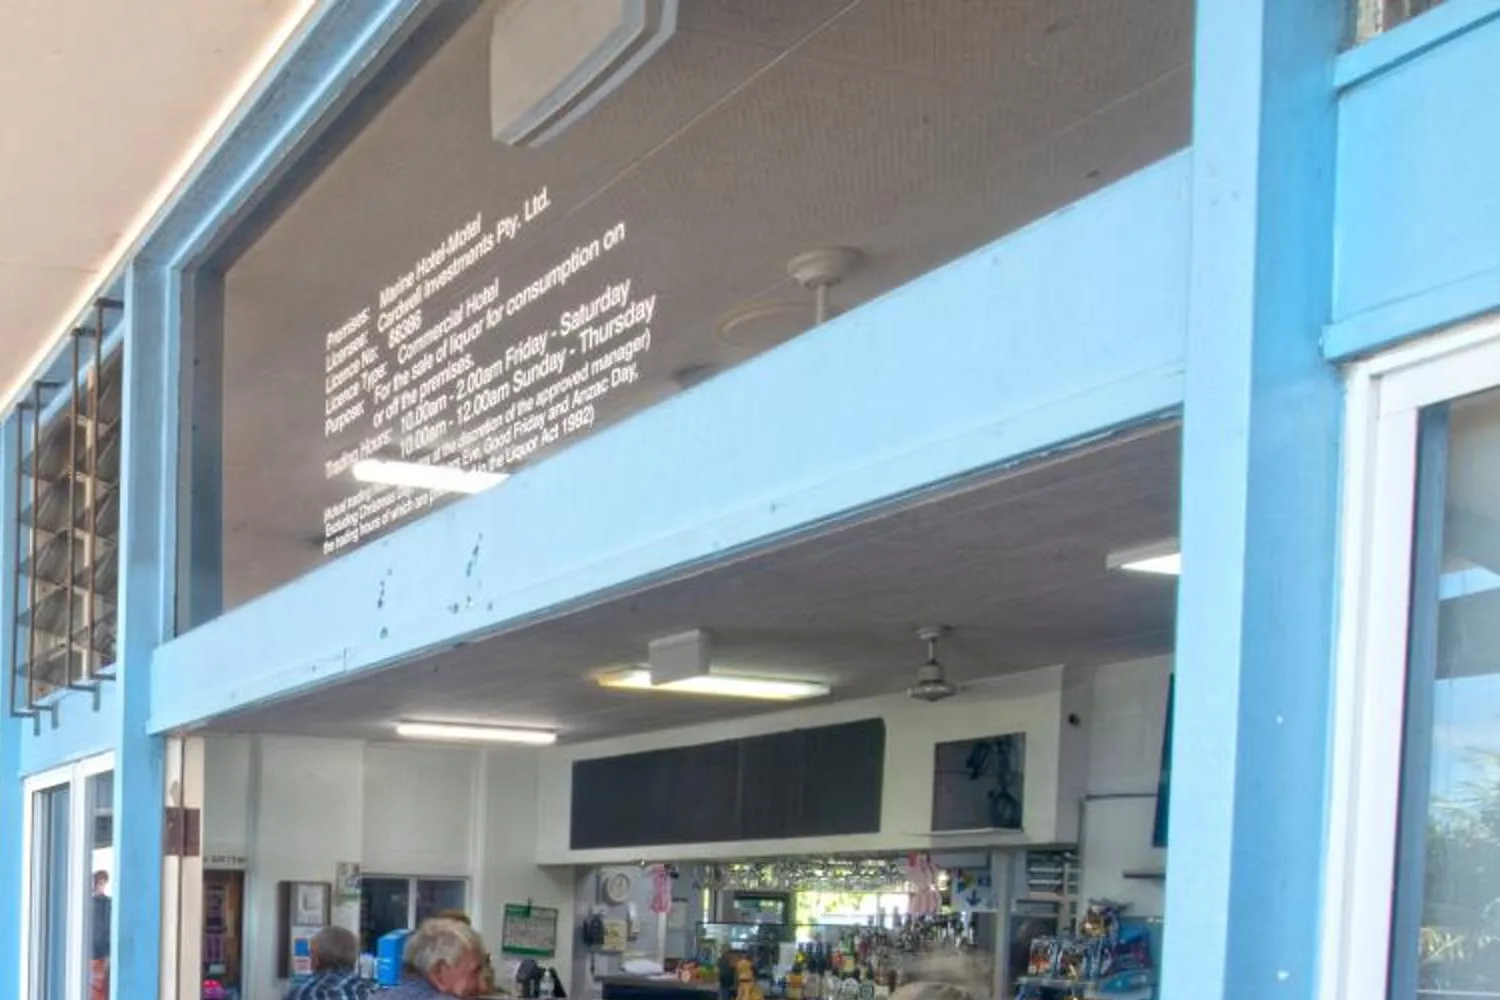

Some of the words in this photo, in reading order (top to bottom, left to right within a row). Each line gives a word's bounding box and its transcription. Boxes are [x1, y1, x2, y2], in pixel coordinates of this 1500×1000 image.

[496, 214, 521, 244] Pty.
[524, 186, 550, 222] Ltd.
[415, 213, 481, 281] Hotel-Motel
[374, 381, 391, 404] For
[411, 353, 434, 380] sale
[435, 338, 448, 363] of
[486, 304, 504, 329] for
[506, 240, 600, 316] consumption
[603, 223, 625, 250] on
[465, 278, 499, 318] Hotel
[505, 331, 547, 371] Friday
[560, 279, 631, 336] Saturday
[513, 348, 566, 393] Sunday
[578, 295, 656, 353] Thursday
[399, 388, 418, 411] the
[419, 352, 475, 403] premises.
[513, 404, 546, 440] Friday
[547, 394, 569, 421] and
